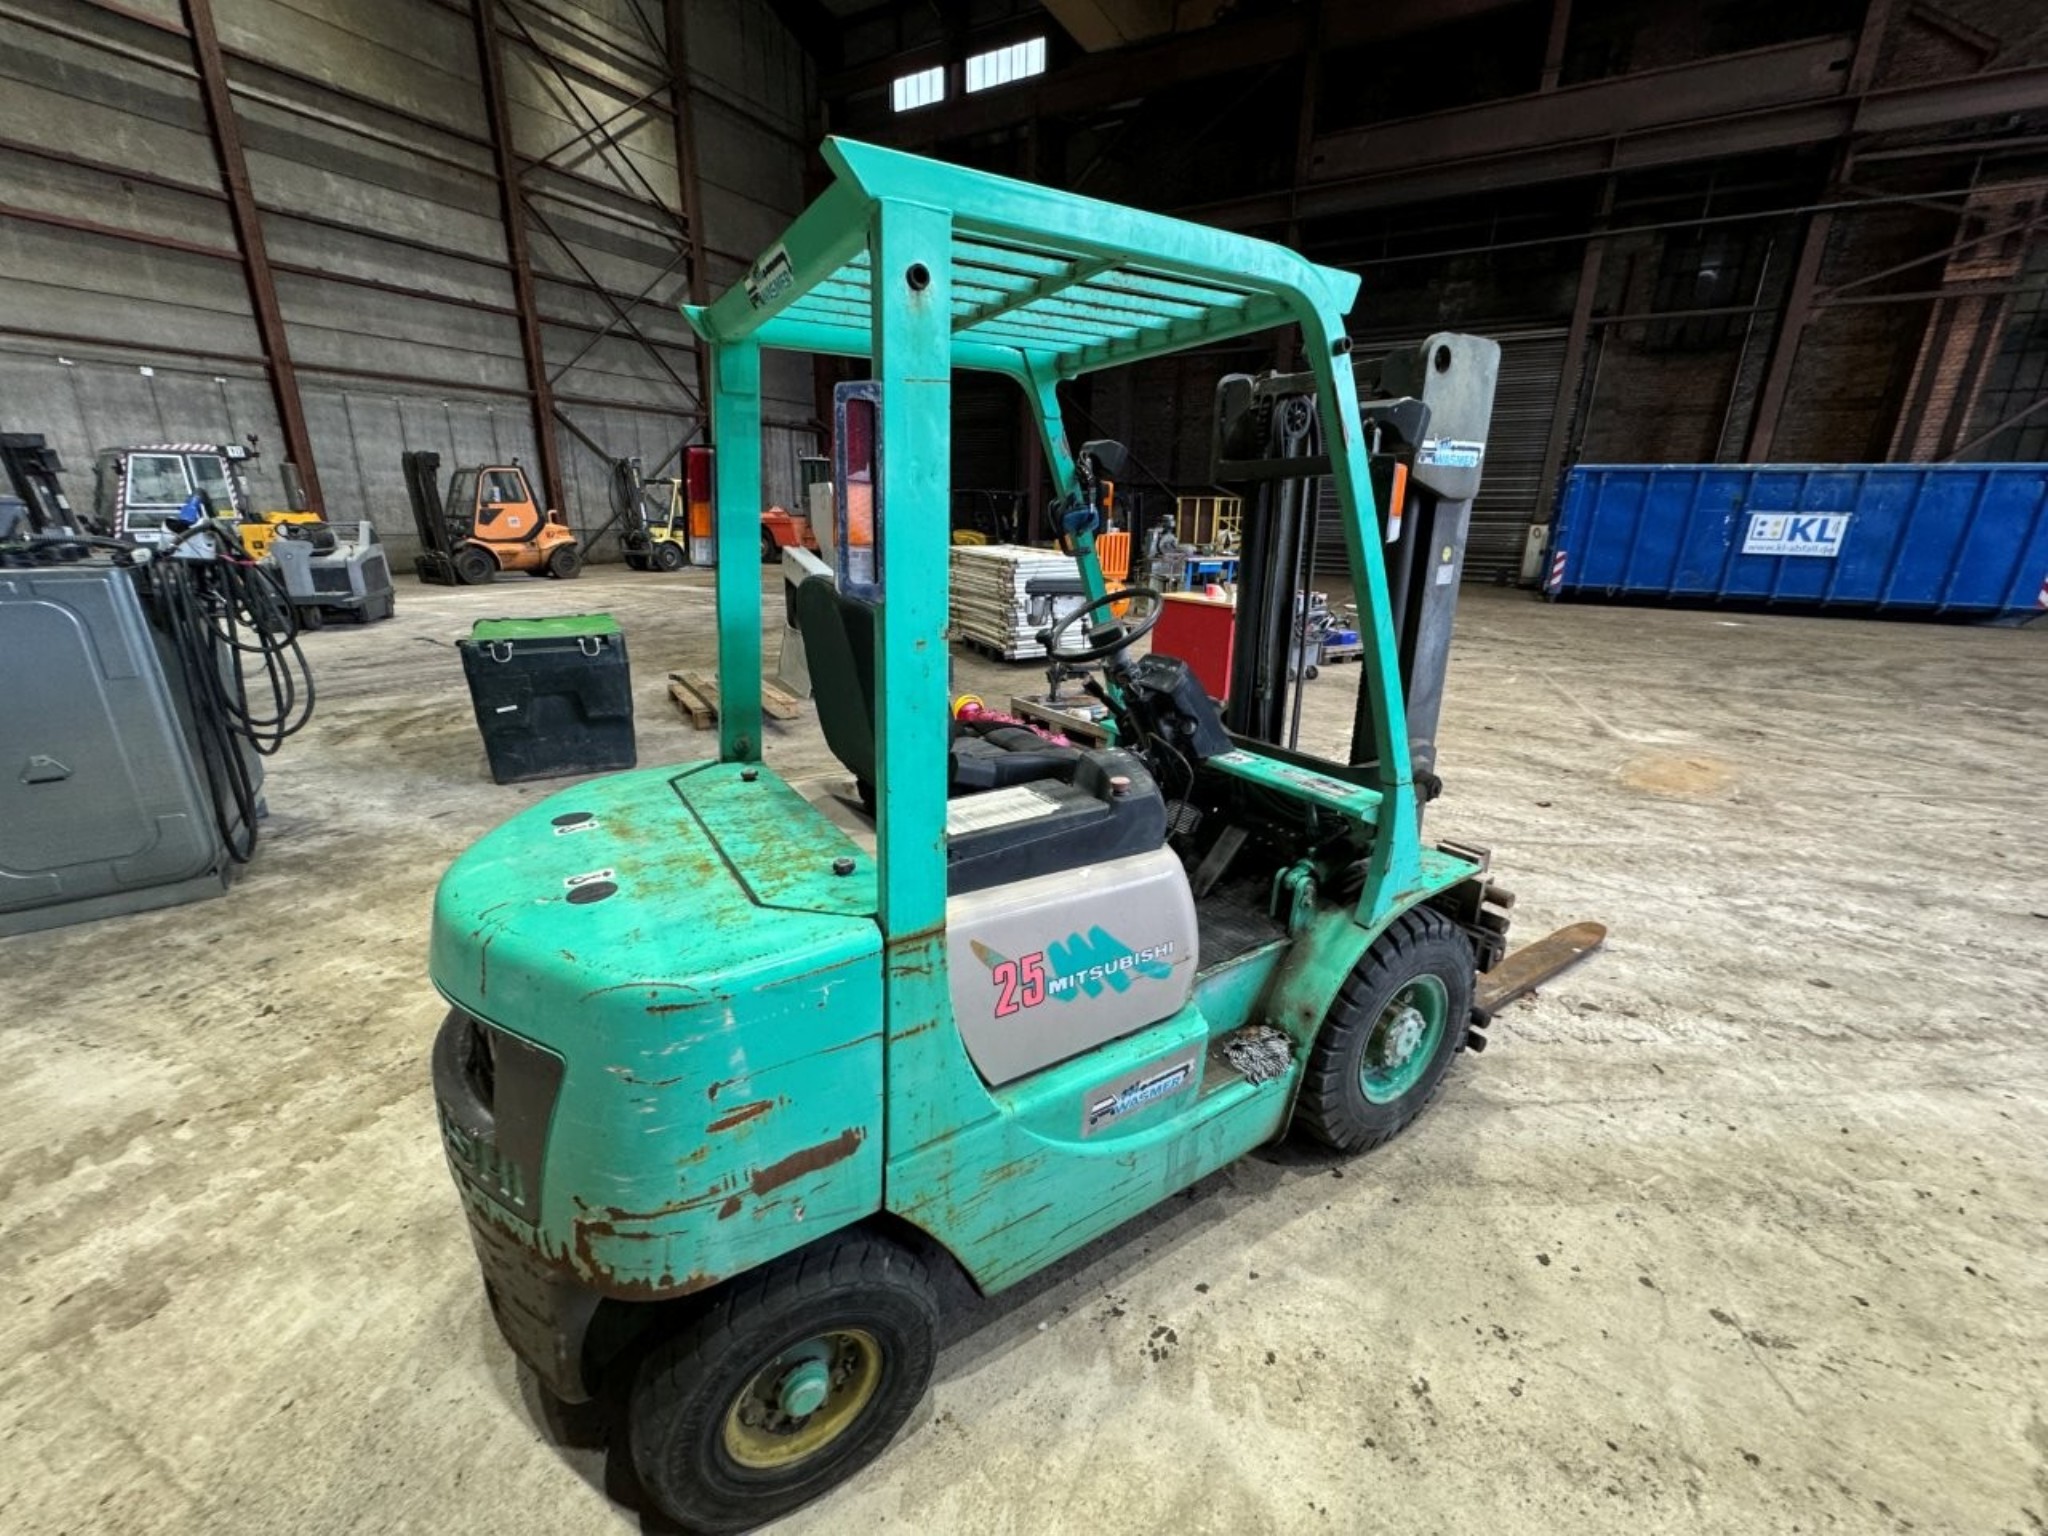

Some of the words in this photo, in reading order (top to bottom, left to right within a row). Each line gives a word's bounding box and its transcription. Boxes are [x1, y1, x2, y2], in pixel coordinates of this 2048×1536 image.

[1787, 517, 1836, 542] KL
[1748, 543, 1835, 554] www.kl-abfall.de
[993, 951, 1044, 1018] 25
[1049, 941, 1174, 994] MITSUBISHI
[1115, 1076, 1181, 1114] WASMER
